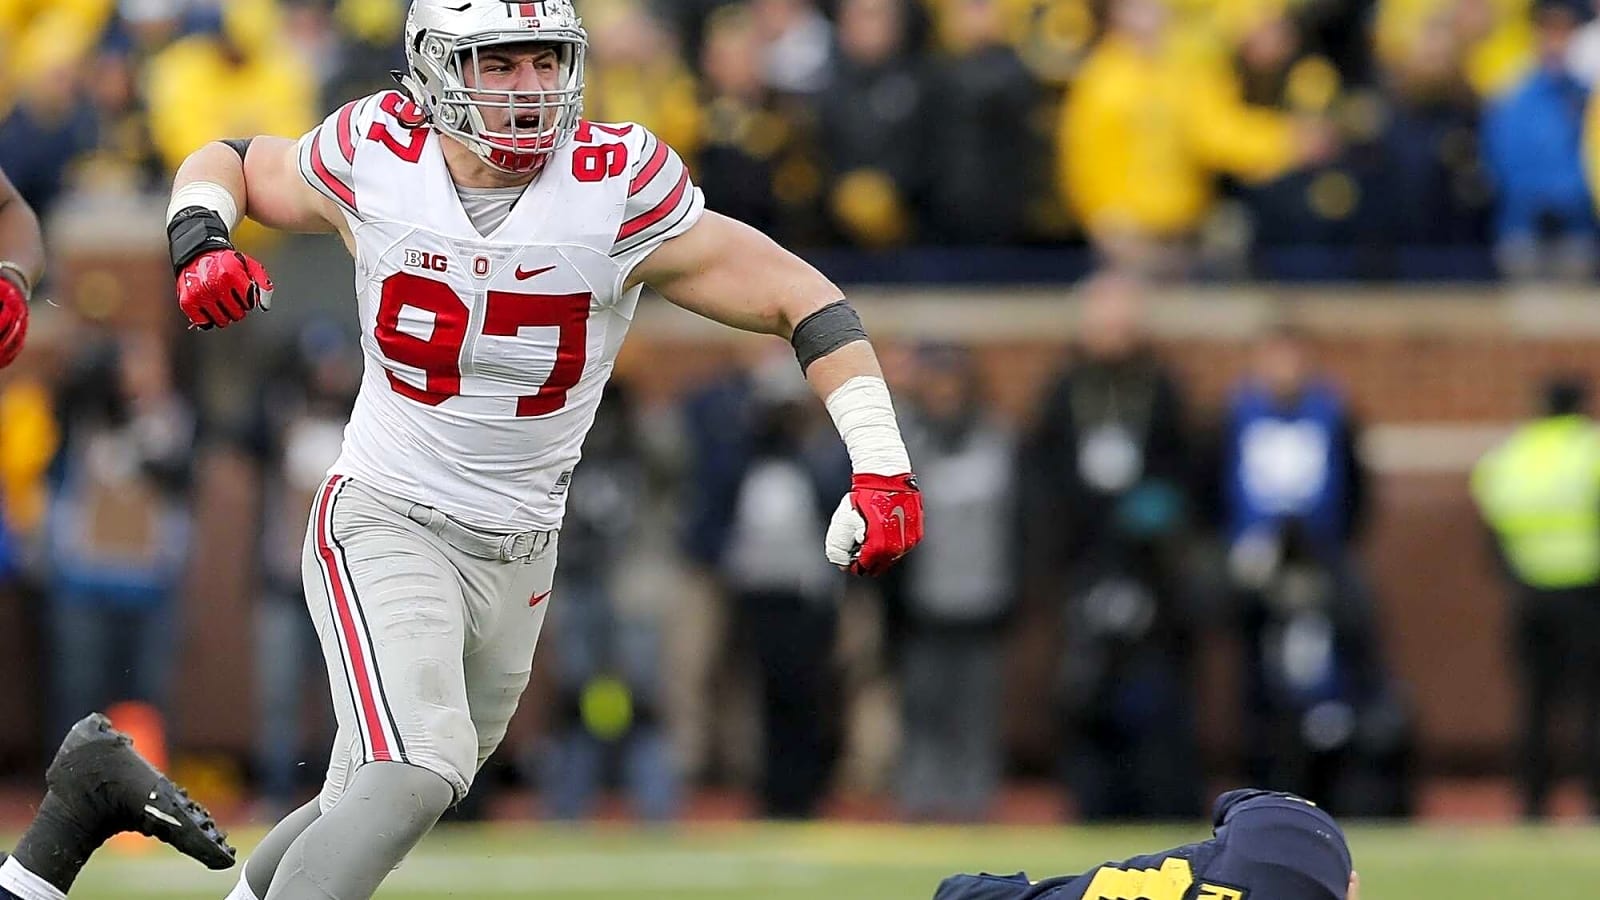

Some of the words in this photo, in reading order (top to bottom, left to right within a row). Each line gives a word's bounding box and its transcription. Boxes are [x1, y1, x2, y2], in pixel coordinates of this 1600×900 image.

[368, 92, 430, 164] 97
[572, 119, 633, 182] 97
[374, 271, 593, 417] 97
